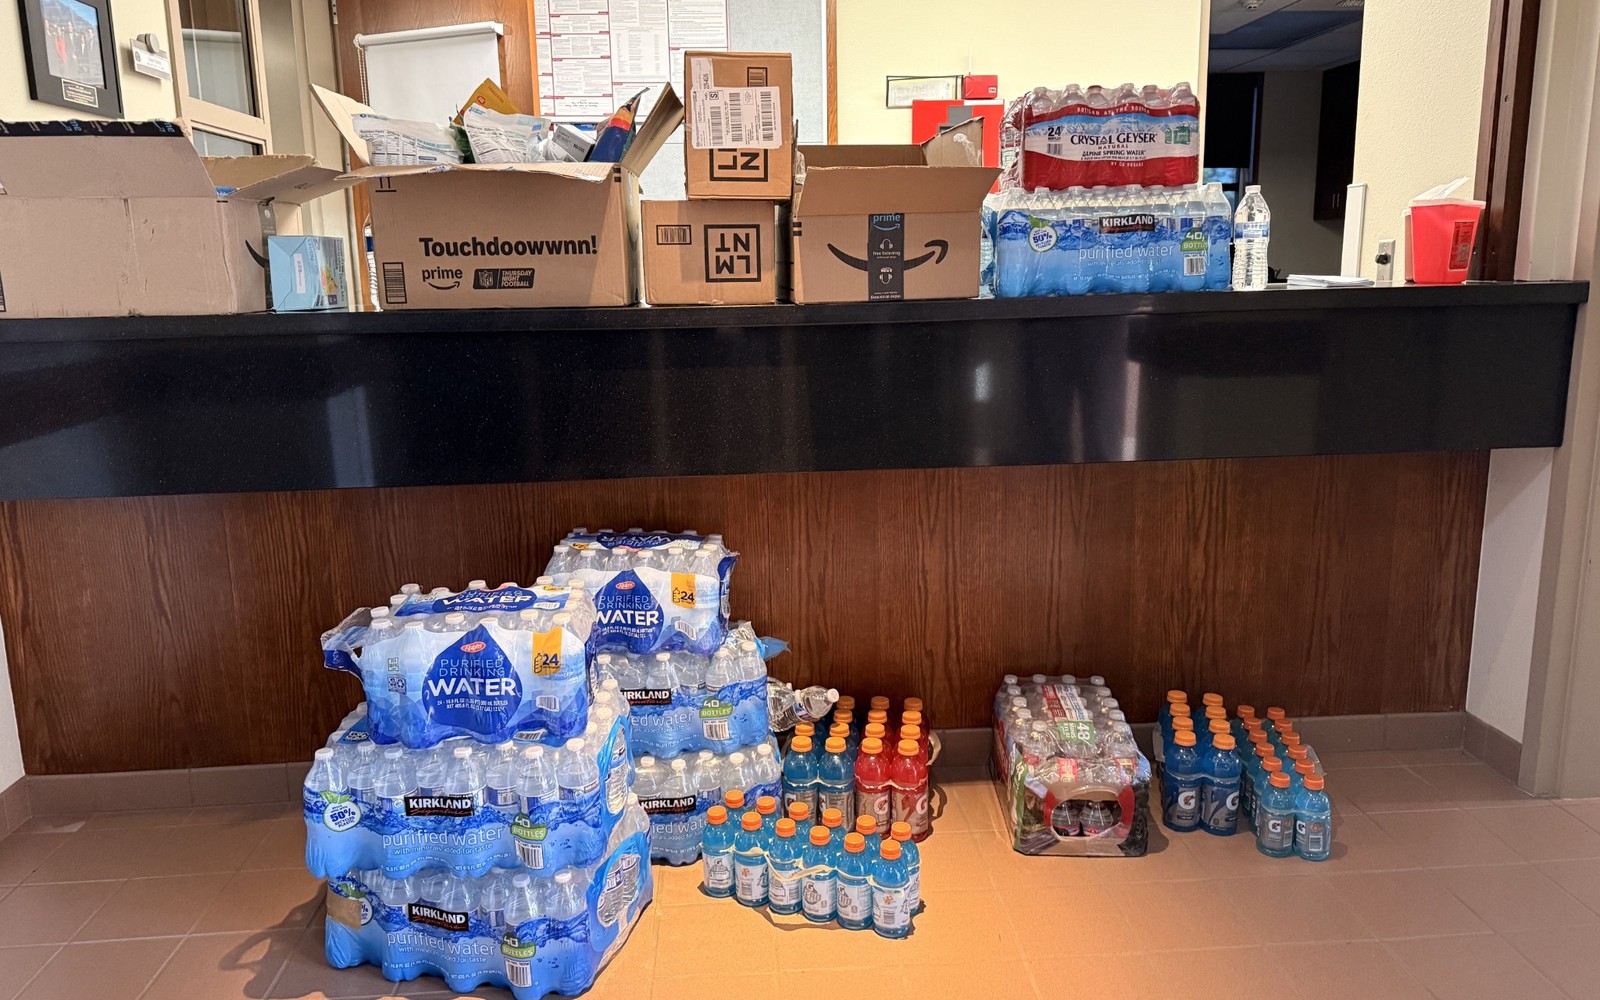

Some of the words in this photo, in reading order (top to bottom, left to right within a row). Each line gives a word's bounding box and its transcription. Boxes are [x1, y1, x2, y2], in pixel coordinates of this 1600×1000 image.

[1048, 126, 1061, 136] 24
[1070, 134, 1114, 145] CRYSTAL
[1116, 133, 1156, 143] GEYSER
[873, 214, 900, 223] prime
[1102, 216, 1154, 227] KIRKLAND
[1033, 232, 1052, 243] 50%
[419, 235, 598, 257] Touchdoowwnn!
[1079, 244, 1133, 262] purified
[1138, 246, 1174, 257] water
[422, 266, 462, 282] prime
[443, 595, 532, 605] WATER
[600, 595, 649, 603] PURIFIED
[681, 591, 694, 602] 24
[596, 610, 659, 626] WATER
[440, 659, 503, 668] PURIFIED
[542, 653, 559, 666] 24
[439, 668, 505, 676] DRINKING
[428, 678, 516, 697] WATER
[624, 690, 669, 700] IRKLAND
[704, 699, 719, 707] 40
[652, 712, 693, 726] water
[1077, 722, 1090, 740] 48
[410, 798, 471, 809] KIRKLAND
[641, 797, 694, 809] KIRKLAND
[871, 797, 886, 814] G
[1178, 792, 1195, 810] G
[1226, 791, 1239, 810] G
[330, 808, 356, 822] 50%
[515, 816, 530, 828] 40
[1268, 820, 1281, 833] G
[1296, 820, 1306, 834] G
[382, 830, 447, 849] purified
[452, 827, 502, 846] water
[514, 827, 544, 838] BOTTLES
[474, 843, 493, 853] taste
[412, 906, 466, 924] KIRKLAND
[387, 932, 444, 950] purified
[448, 943, 495, 955] water
[504, 936, 518, 947] 40
[503, 948, 532, 956] BOTTLES
